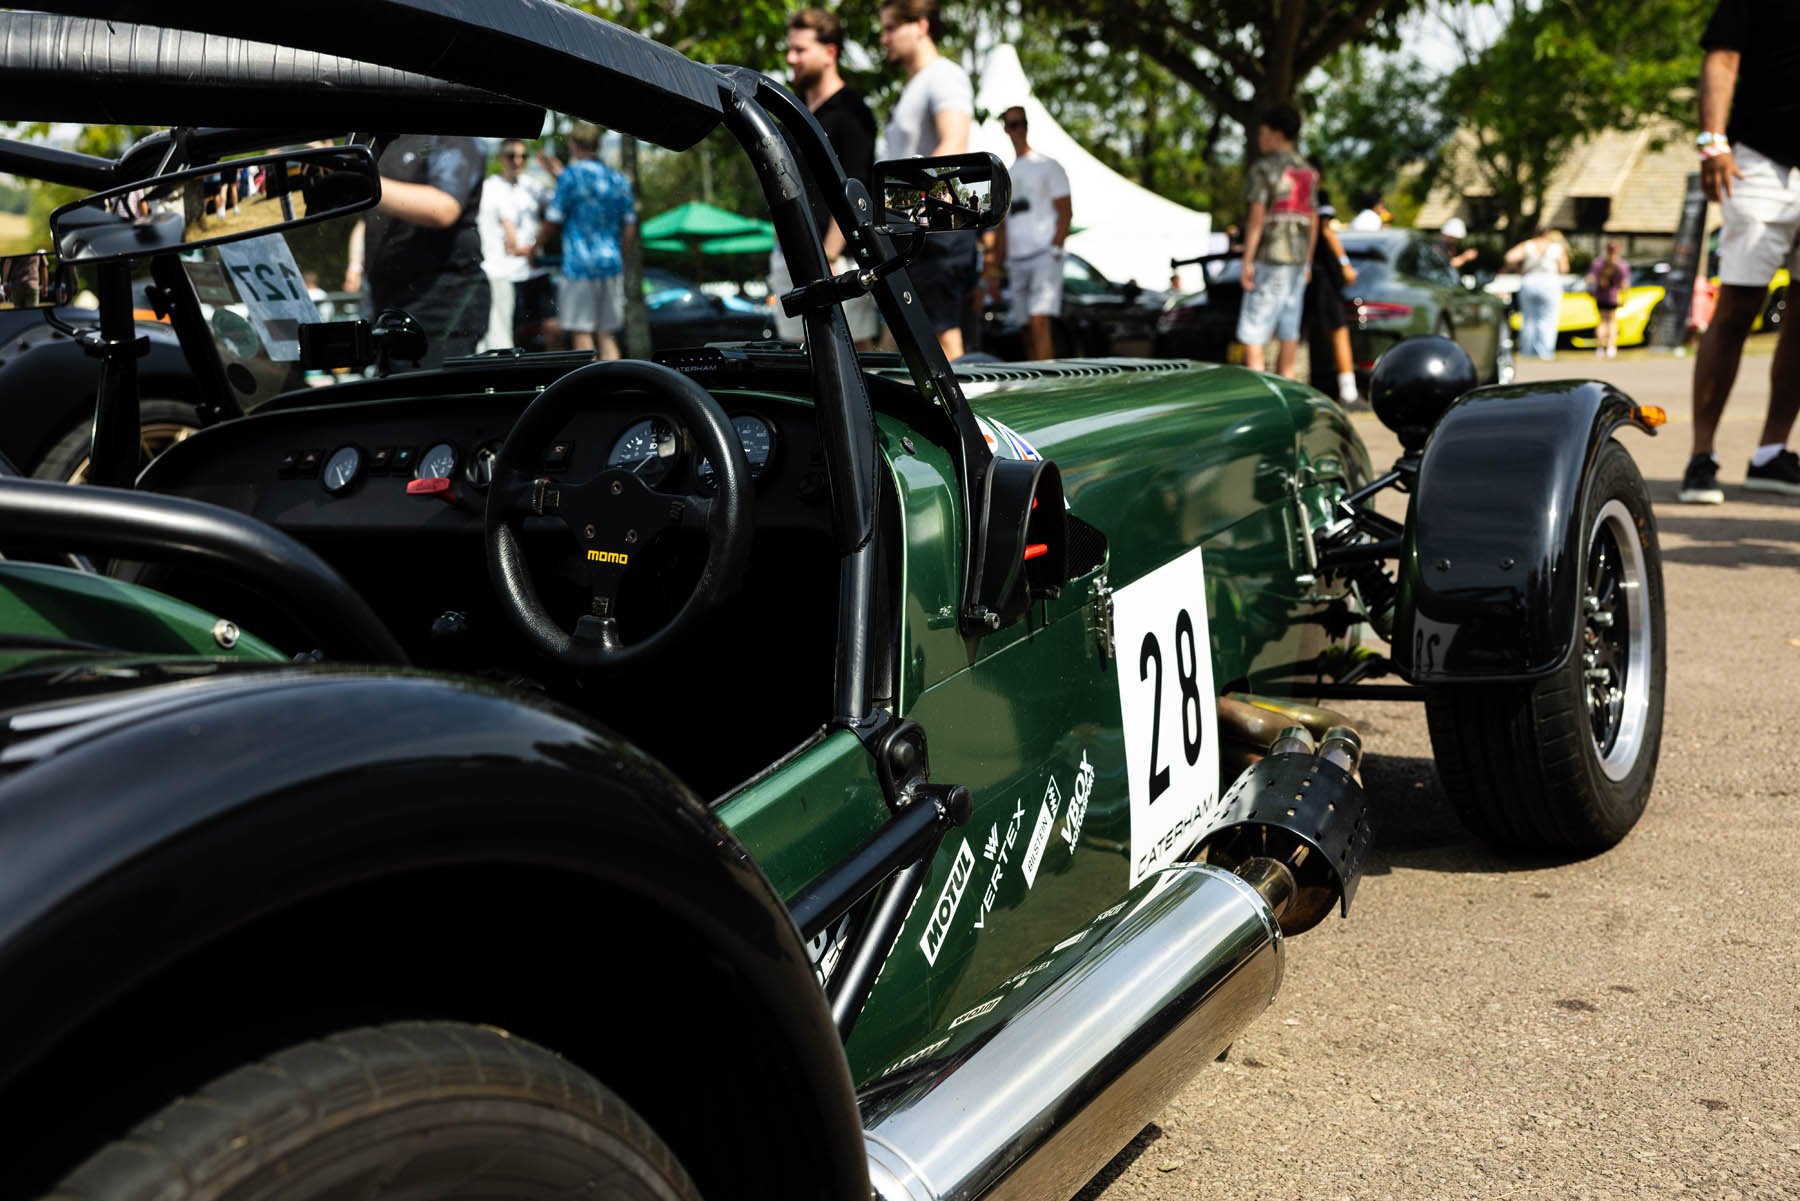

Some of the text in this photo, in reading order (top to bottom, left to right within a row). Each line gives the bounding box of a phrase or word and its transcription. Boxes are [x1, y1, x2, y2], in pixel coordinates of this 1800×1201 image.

[1139, 608, 1203, 807] 28
[1060, 748, 1092, 844] VBOX
[1067, 765, 1096, 856] MOTORSPORT
[1136, 792, 1214, 880] CATERHAM
[973, 797, 1026, 929] VERTEX
[1026, 816, 1049, 873] BILSTEIN
[925, 848, 973, 959] MOTUL
